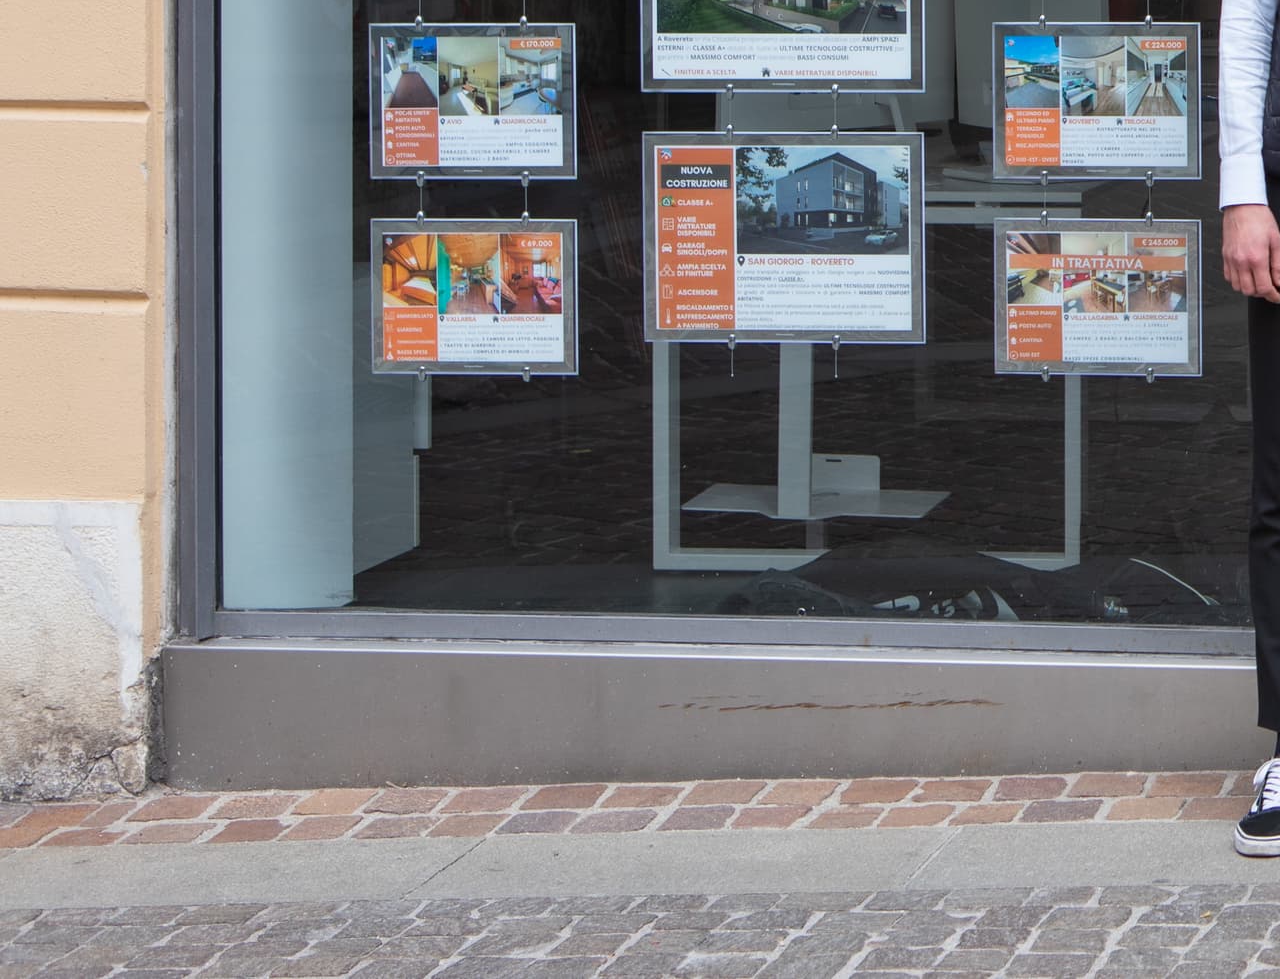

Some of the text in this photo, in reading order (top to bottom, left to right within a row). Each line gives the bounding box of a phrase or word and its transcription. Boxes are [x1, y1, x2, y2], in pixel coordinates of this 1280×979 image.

[680, 167, 713, 175] NUOVA
[666, 179, 728, 188] COSTRUZIONE
[748, 258, 765, 266] SAN
[767, 258, 804, 266] GIORGIO
[811, 258, 854, 266] ROVERETO
[1052, 258, 1143, 270] IN TRATTATIVA
